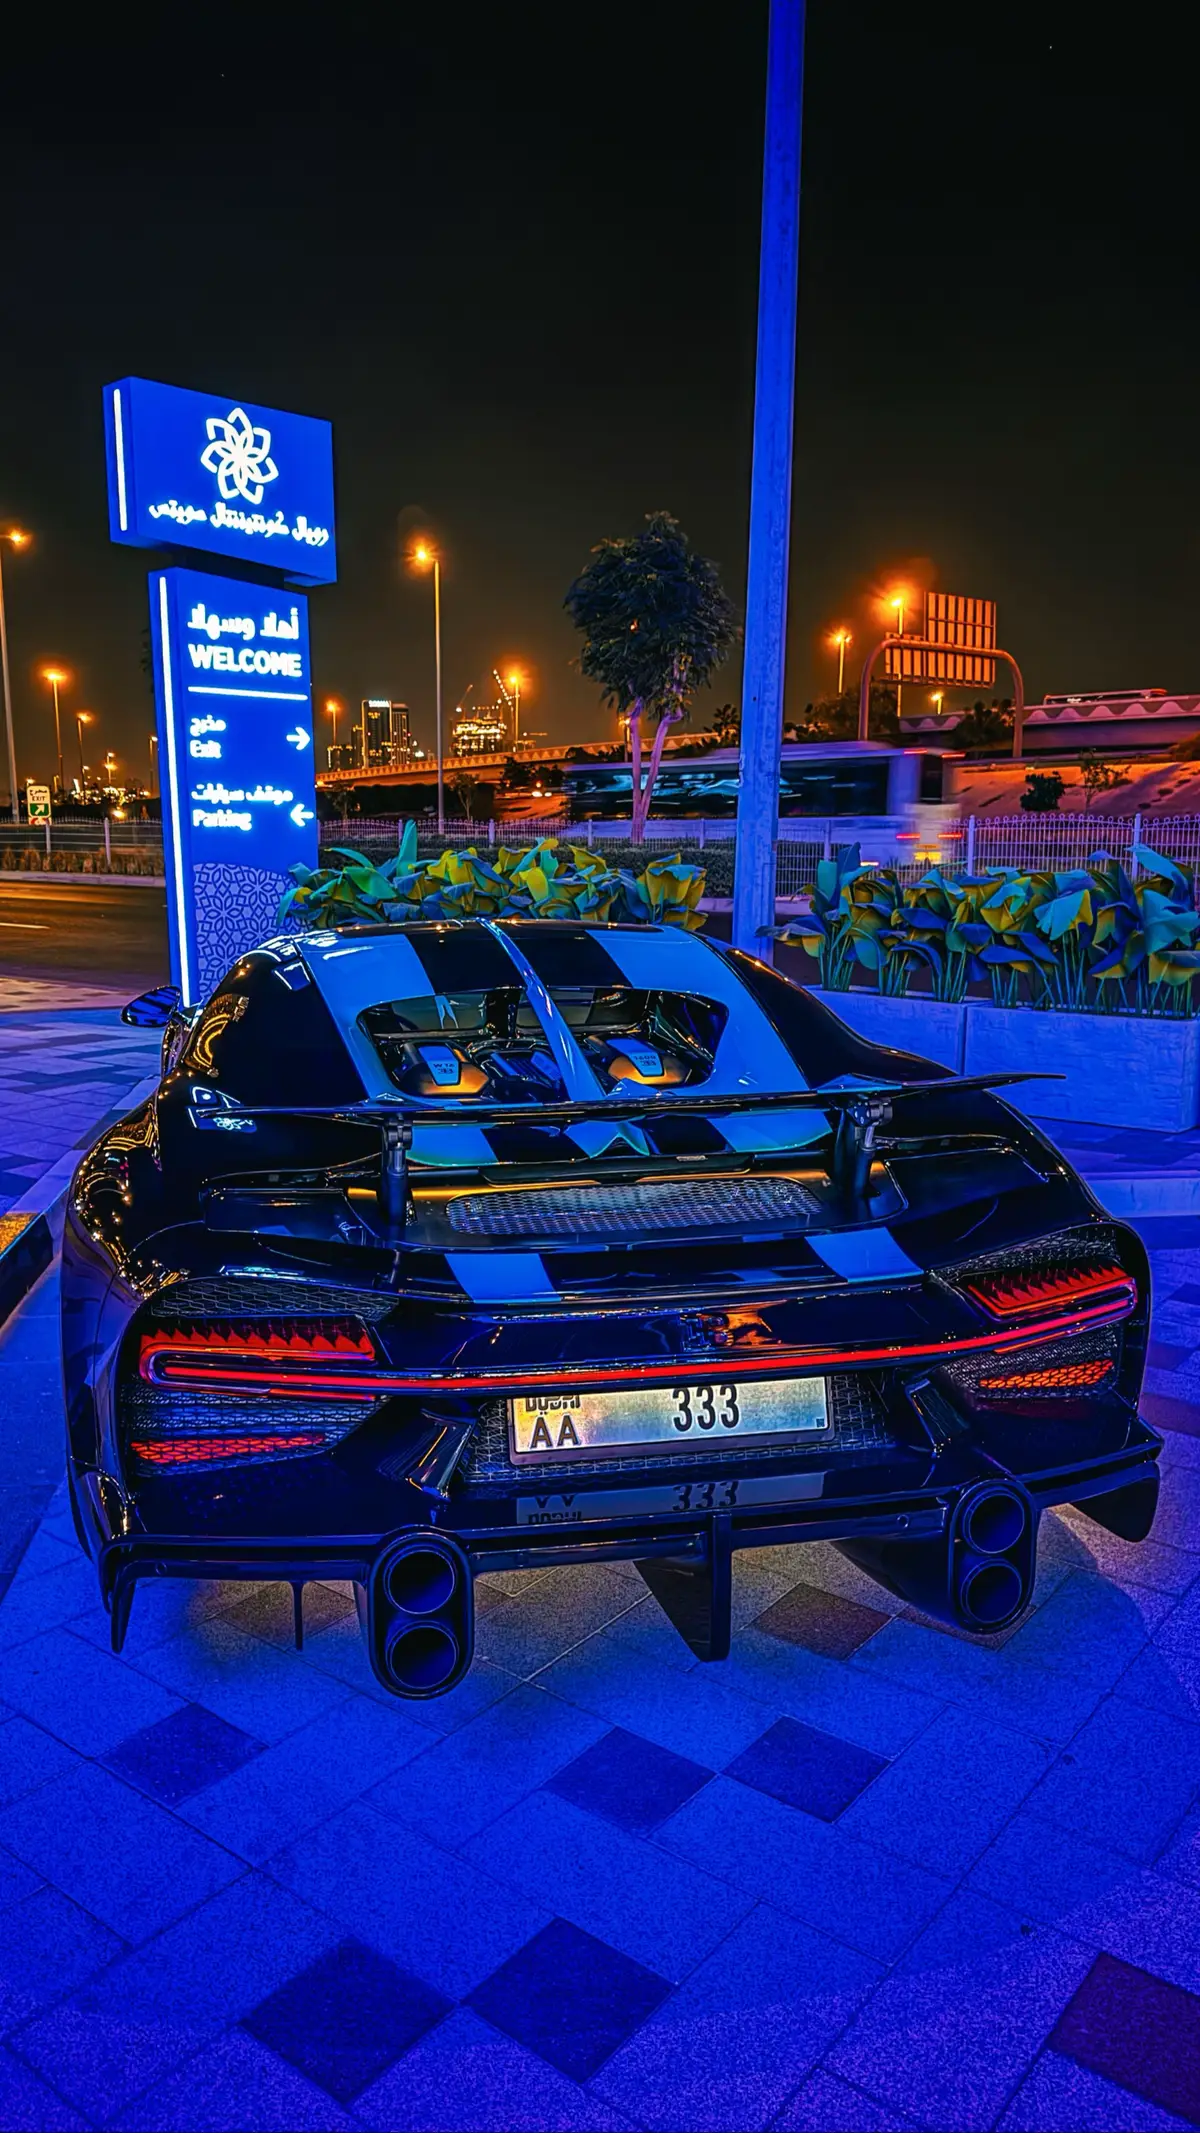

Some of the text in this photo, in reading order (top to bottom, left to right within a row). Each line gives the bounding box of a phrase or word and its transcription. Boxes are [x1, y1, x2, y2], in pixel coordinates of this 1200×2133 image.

[187, 643, 303, 678] WELCOME
[189, 714, 227, 737] مخرج
[189, 739, 222, 759] Exit
[191, 782, 294, 806] موقف سيارات
[192, 809, 253, 831] Parking
[672, 1384, 740, 1432] 333
